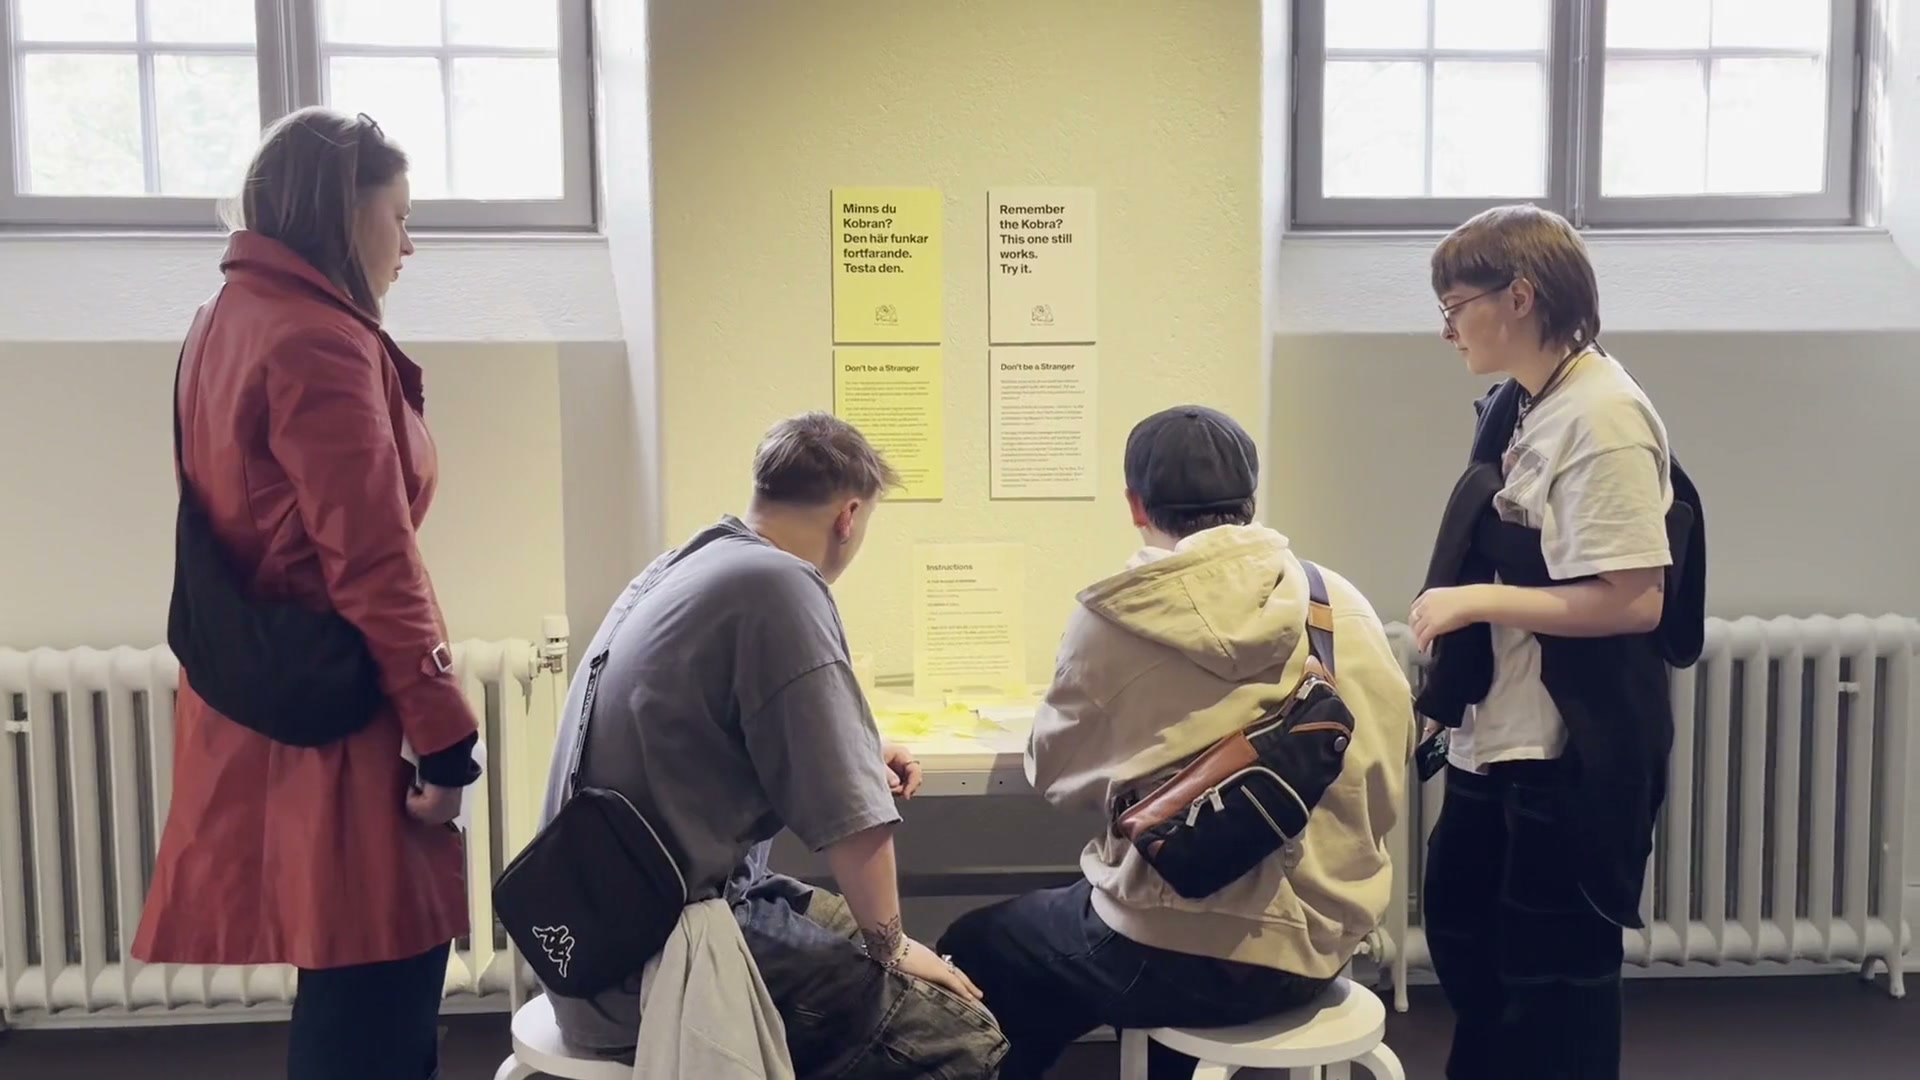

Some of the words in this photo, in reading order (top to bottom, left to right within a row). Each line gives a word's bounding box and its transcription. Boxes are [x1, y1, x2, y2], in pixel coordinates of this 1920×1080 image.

[843, 204, 878, 213] Minns
[882, 204, 896, 213] du
[1000, 204, 1065, 214] Remember
[843, 218, 892, 228] Kobran?
[1000, 220, 1019, 229] the
[1022, 219, 1063, 229] Kobra?
[844, 233, 867, 243] Den
[870, 234, 888, 243] här
[891, 234, 928, 243] funkar
[1000, 234, 1025, 244] This
[1027, 236, 1049, 244] one
[1052, 234, 1072, 243] still
[843, 248, 912, 258] fortfarande.
[1000, 249, 1038, 259] works.
[844, 263, 876, 273] Testa
[878, 263, 904, 273] den.
[1000, 264, 1018, 276] Try
[1021, 264, 1032, 273] it.
[867, 364, 878, 372] be
[885, 365, 919, 373] Stranger
[1041, 363, 1075, 371] Stranger
